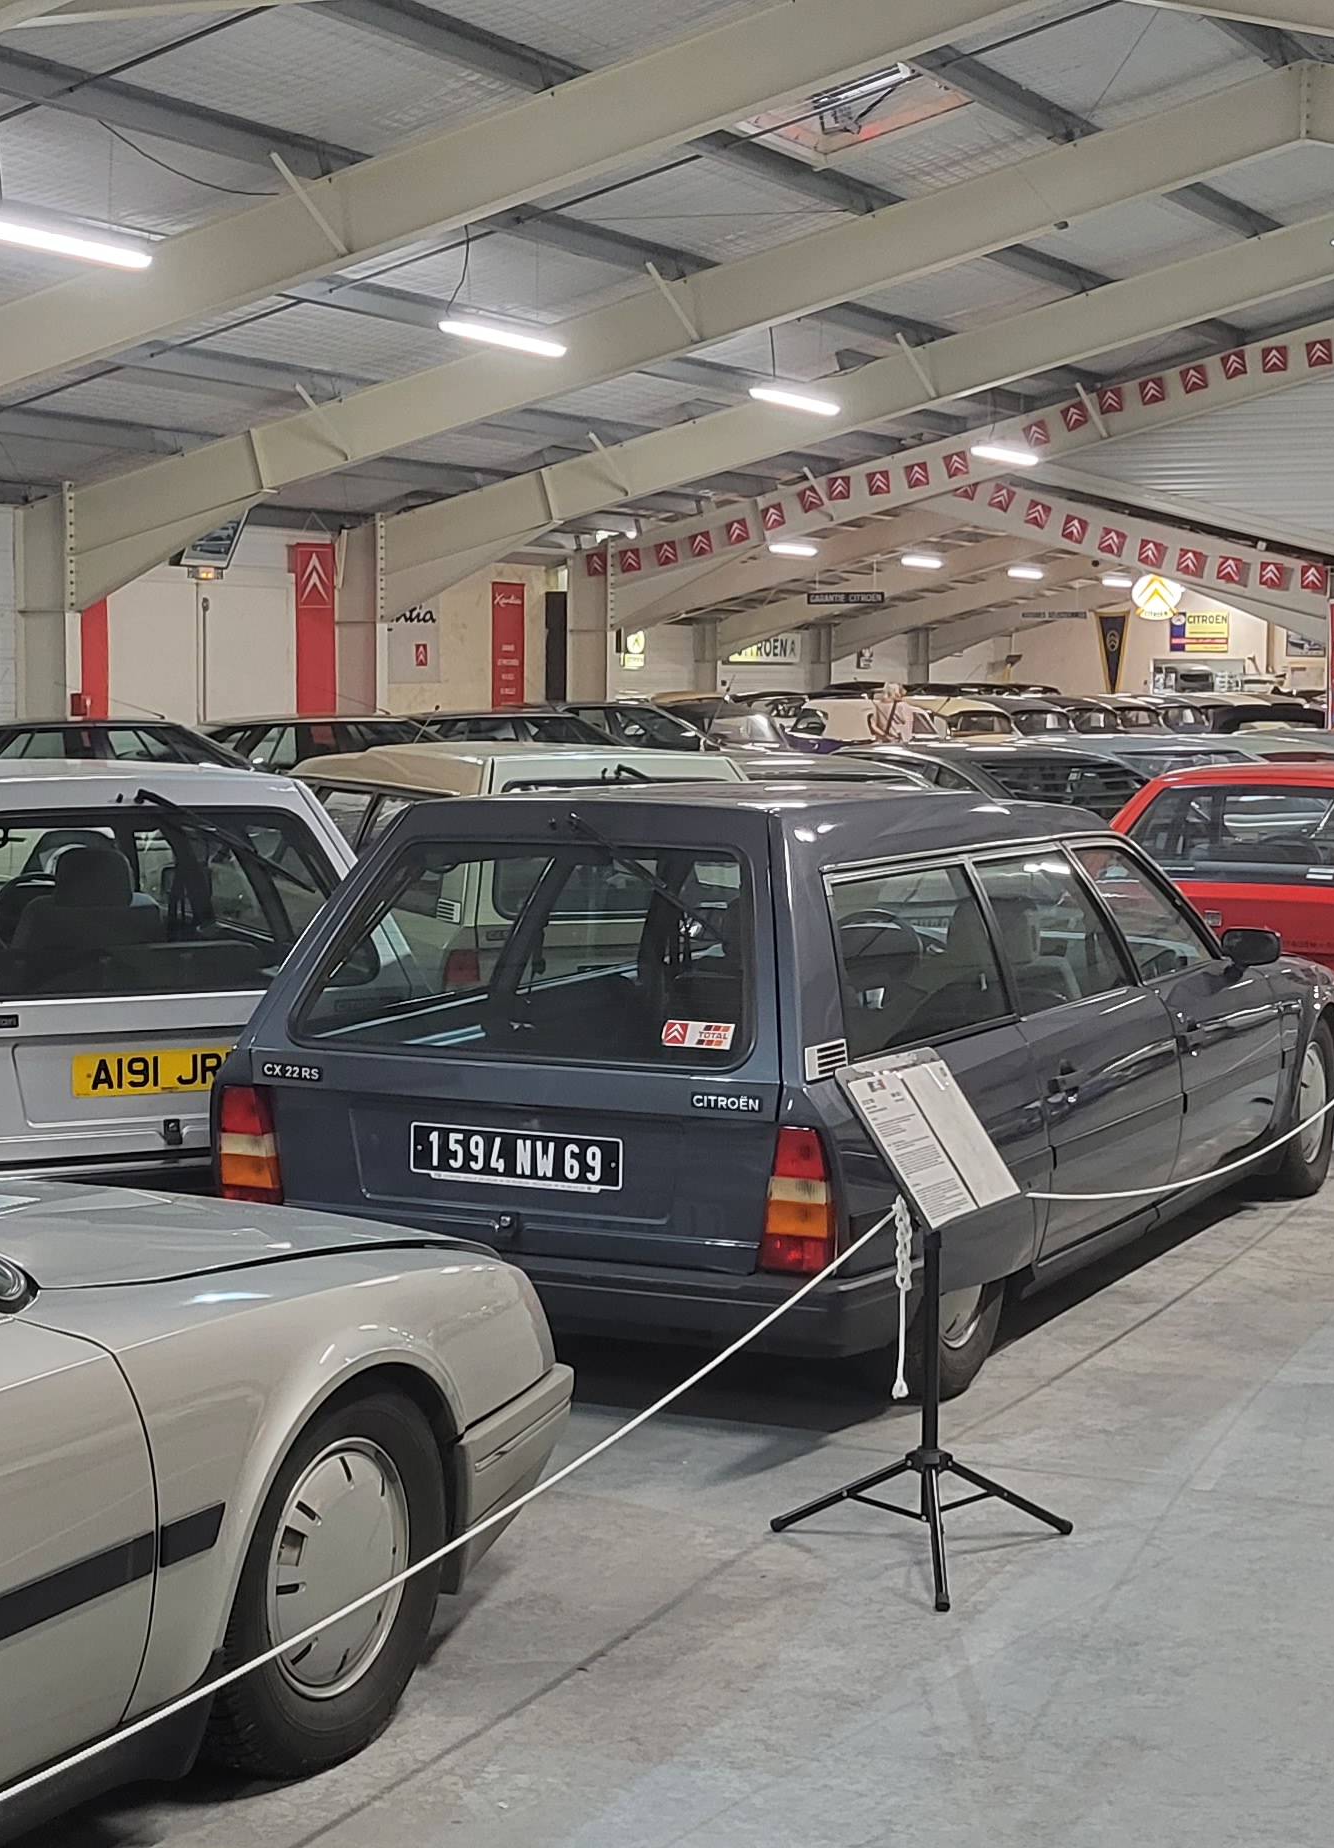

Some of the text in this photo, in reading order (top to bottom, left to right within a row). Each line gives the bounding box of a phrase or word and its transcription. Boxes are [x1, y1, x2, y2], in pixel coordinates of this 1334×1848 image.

[699, 1031, 728, 1040] TOTAL
[91, 1051, 231, 1091] A191 JR
[263, 1063, 282, 1076] CX
[692, 1095, 759, 1111] CITROËN
[429, 1130, 602, 1182] 1594 NW 69
